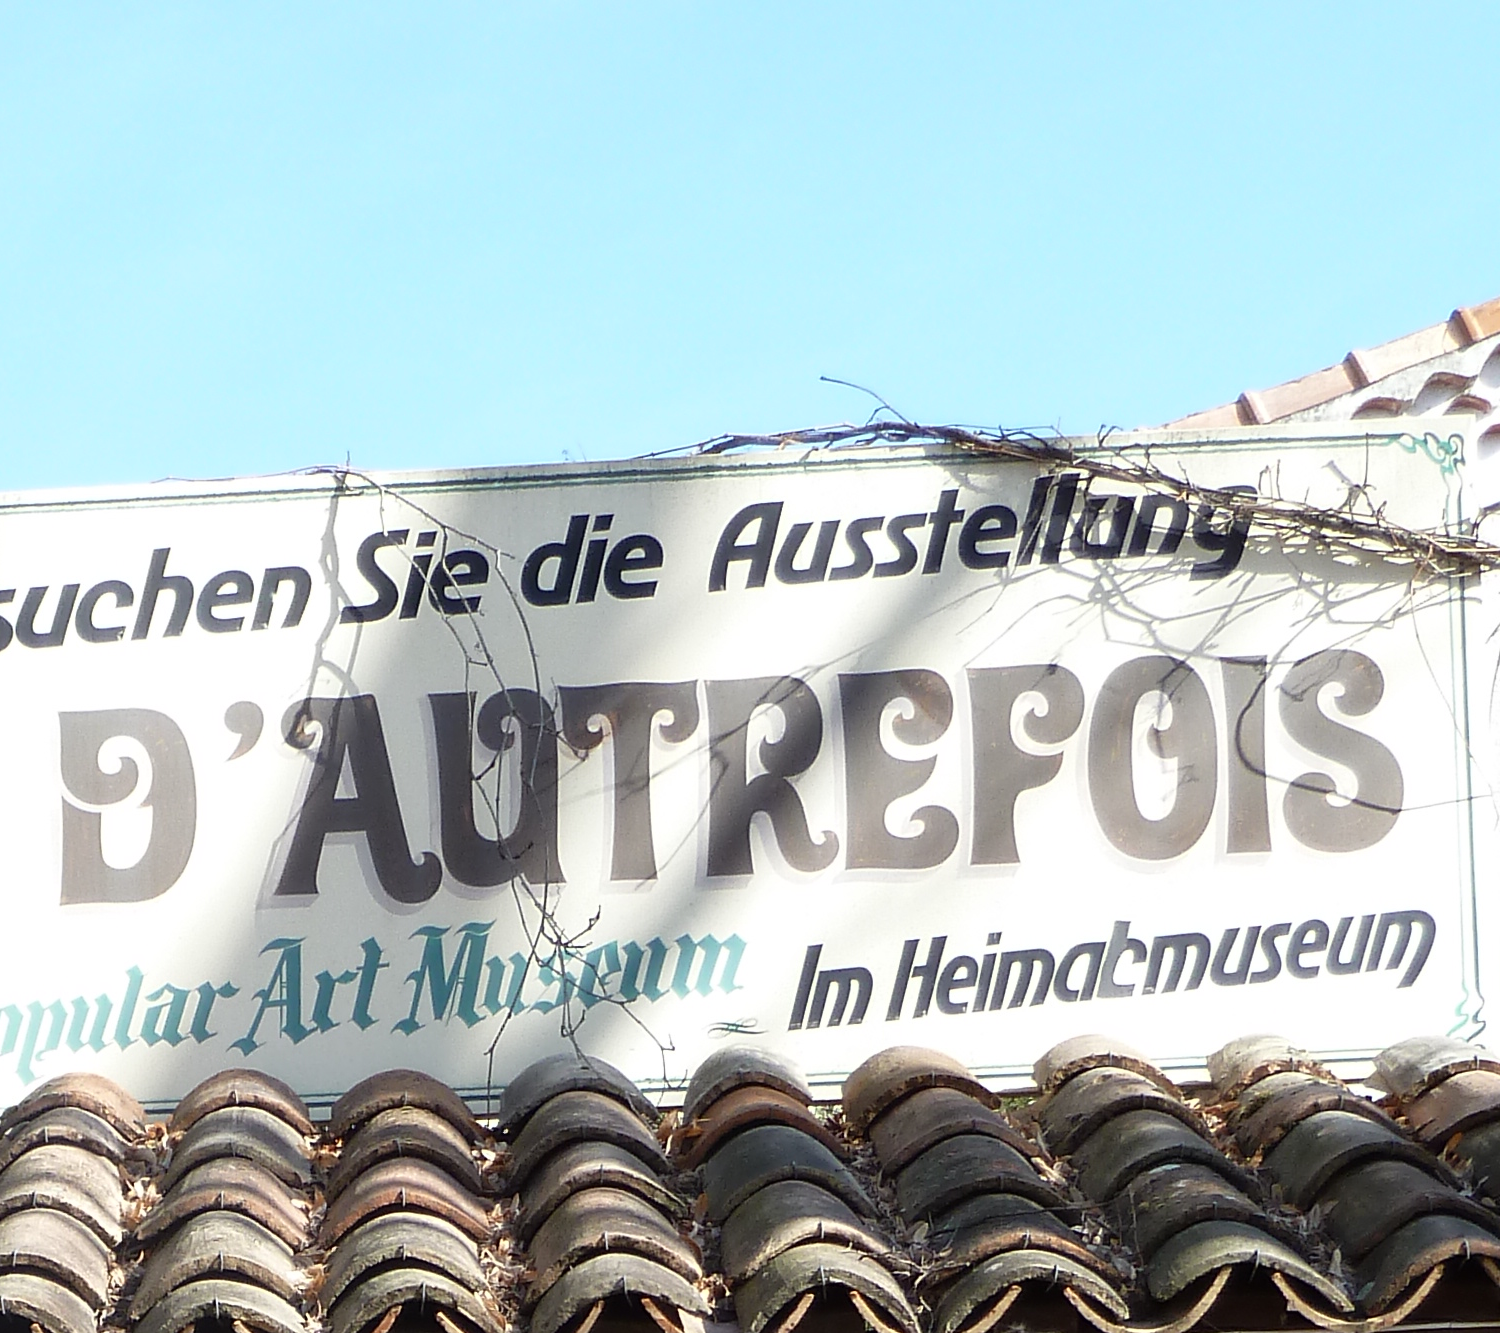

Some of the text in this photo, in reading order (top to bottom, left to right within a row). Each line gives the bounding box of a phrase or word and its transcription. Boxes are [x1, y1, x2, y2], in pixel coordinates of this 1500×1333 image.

[341, 529, 488, 624] Sie
[521, 513, 664, 607] die
[708, 473, 1258, 592] Ausstellung
[59, 649, 1404, 906] D'AUTREFOIS
[227, 935, 389, 1055] Art
[393, 920, 747, 1036] Museum
[788, 910, 1436, 1031] Im Heimatmuseum
